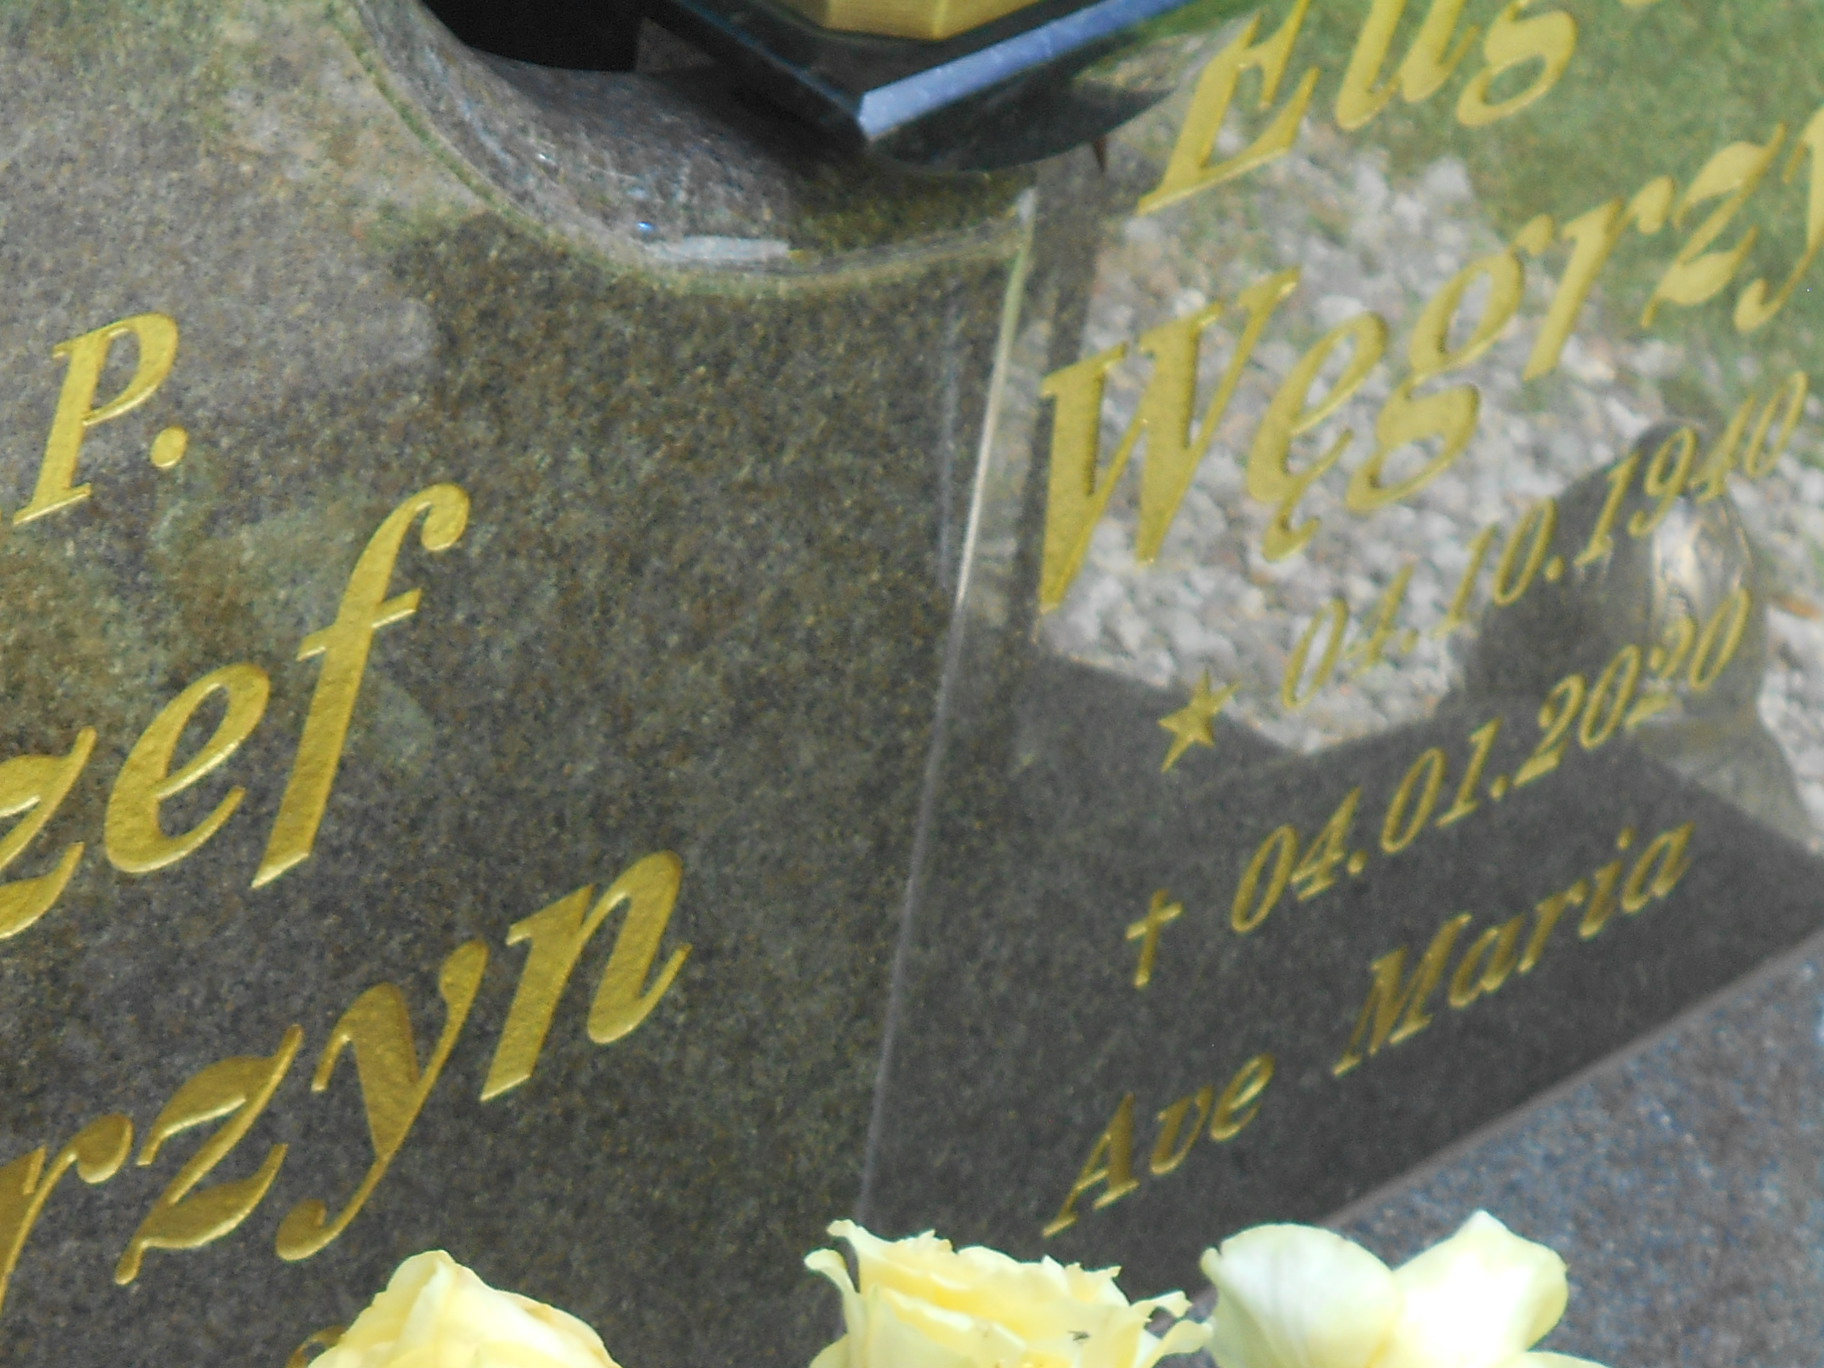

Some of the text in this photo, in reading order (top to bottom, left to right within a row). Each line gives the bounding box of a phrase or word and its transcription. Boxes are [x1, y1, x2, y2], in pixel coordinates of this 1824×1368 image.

[1231, 586, 1752, 933] 04.01.2020
[1042, 818, 1697, 1238] Ave Maria
